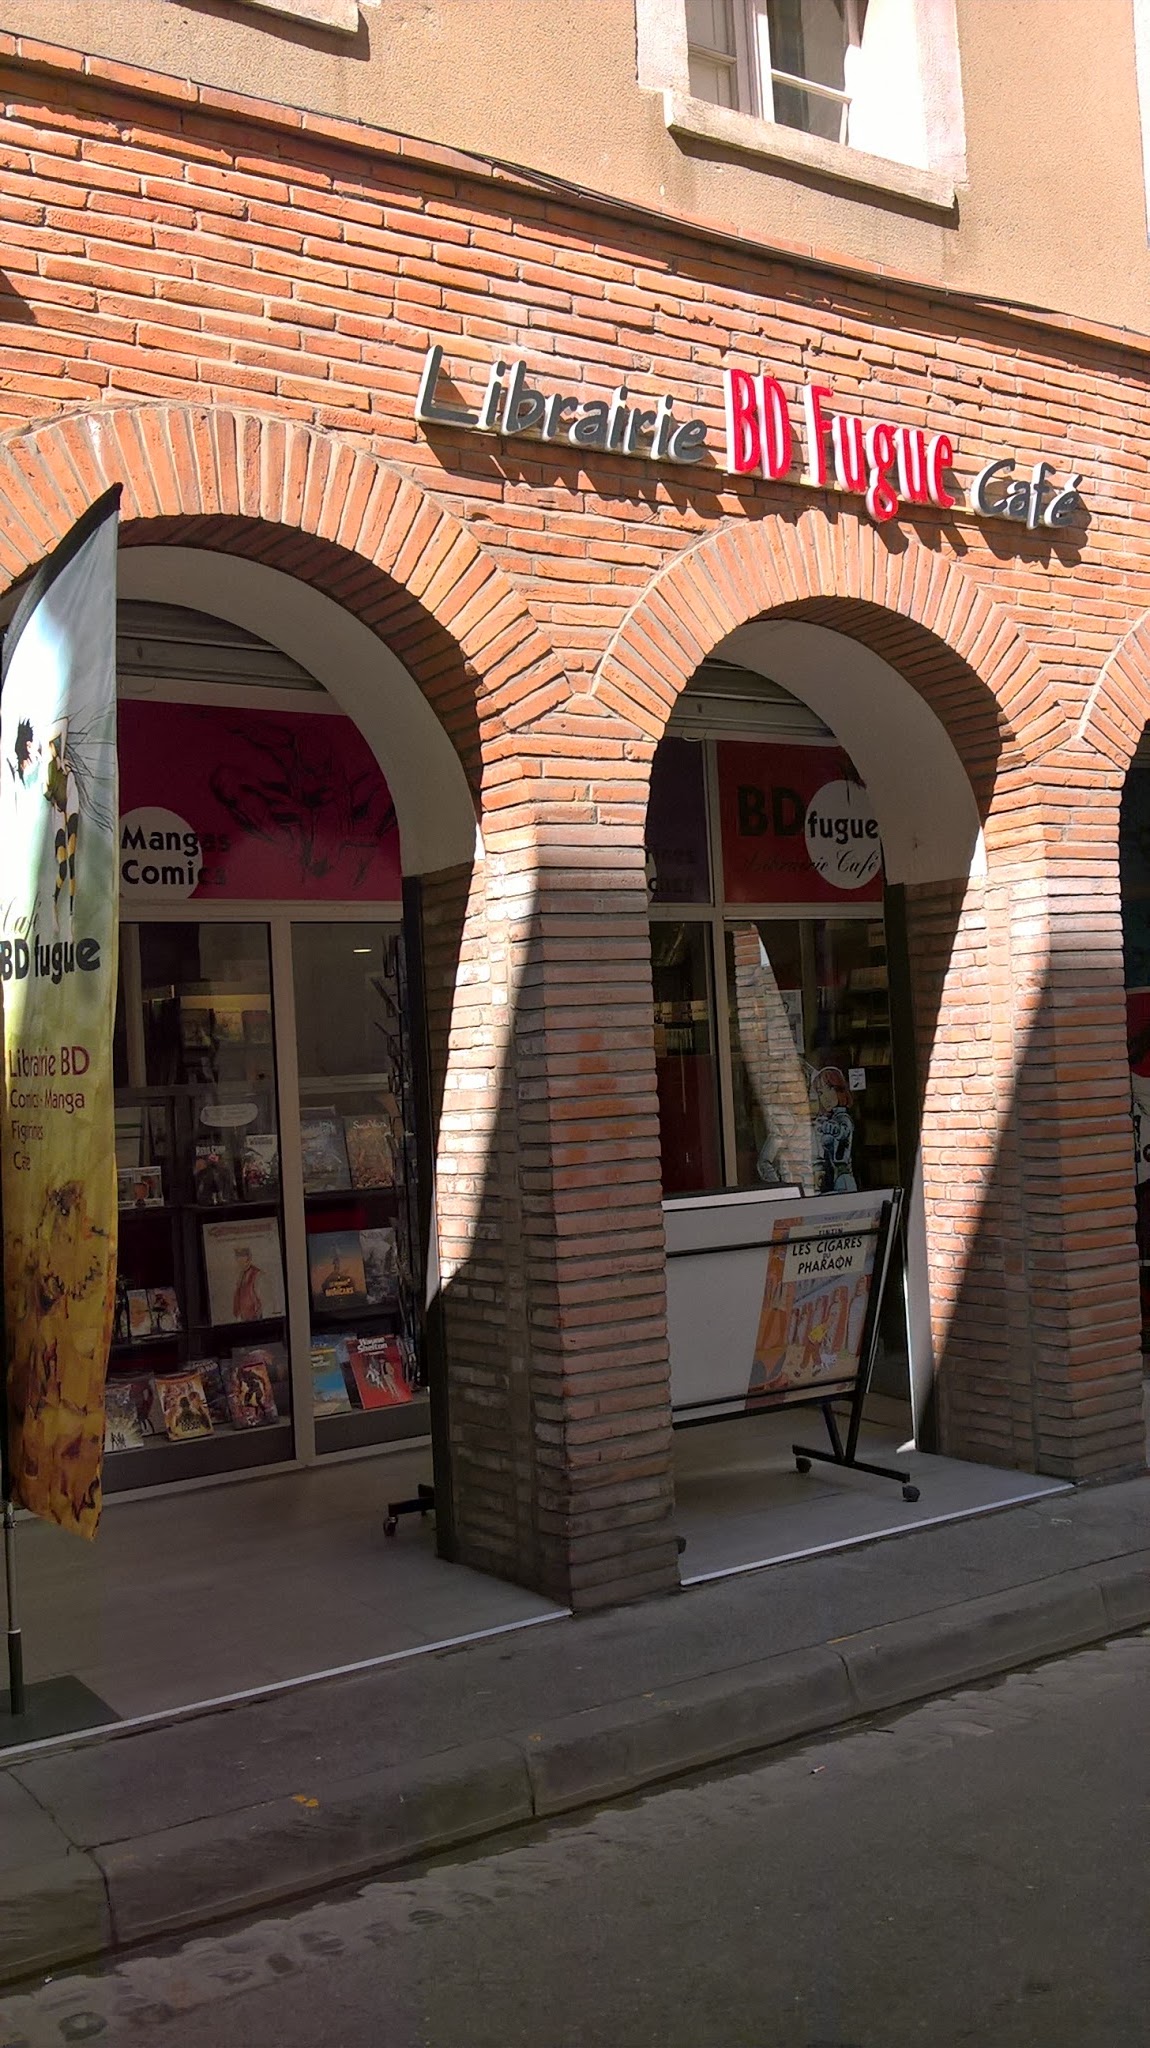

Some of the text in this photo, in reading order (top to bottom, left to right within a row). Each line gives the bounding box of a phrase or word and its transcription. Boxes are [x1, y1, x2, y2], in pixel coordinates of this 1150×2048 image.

[414, 345, 1083, 531] Librairie BD Fugue Café
[737, 784, 878, 845] BD fugue
[121, 825, 231, 857] Mangas
[122, 860, 228, 886] Comics
[836, 849, 879, 878] Café
[0, 933, 101, 985] BD fugue
[61, 1046, 90, 1076] BD
[792, 1236, 863, 1256] LES CIGARES
[798, 1255, 853, 1274] PHARAON
